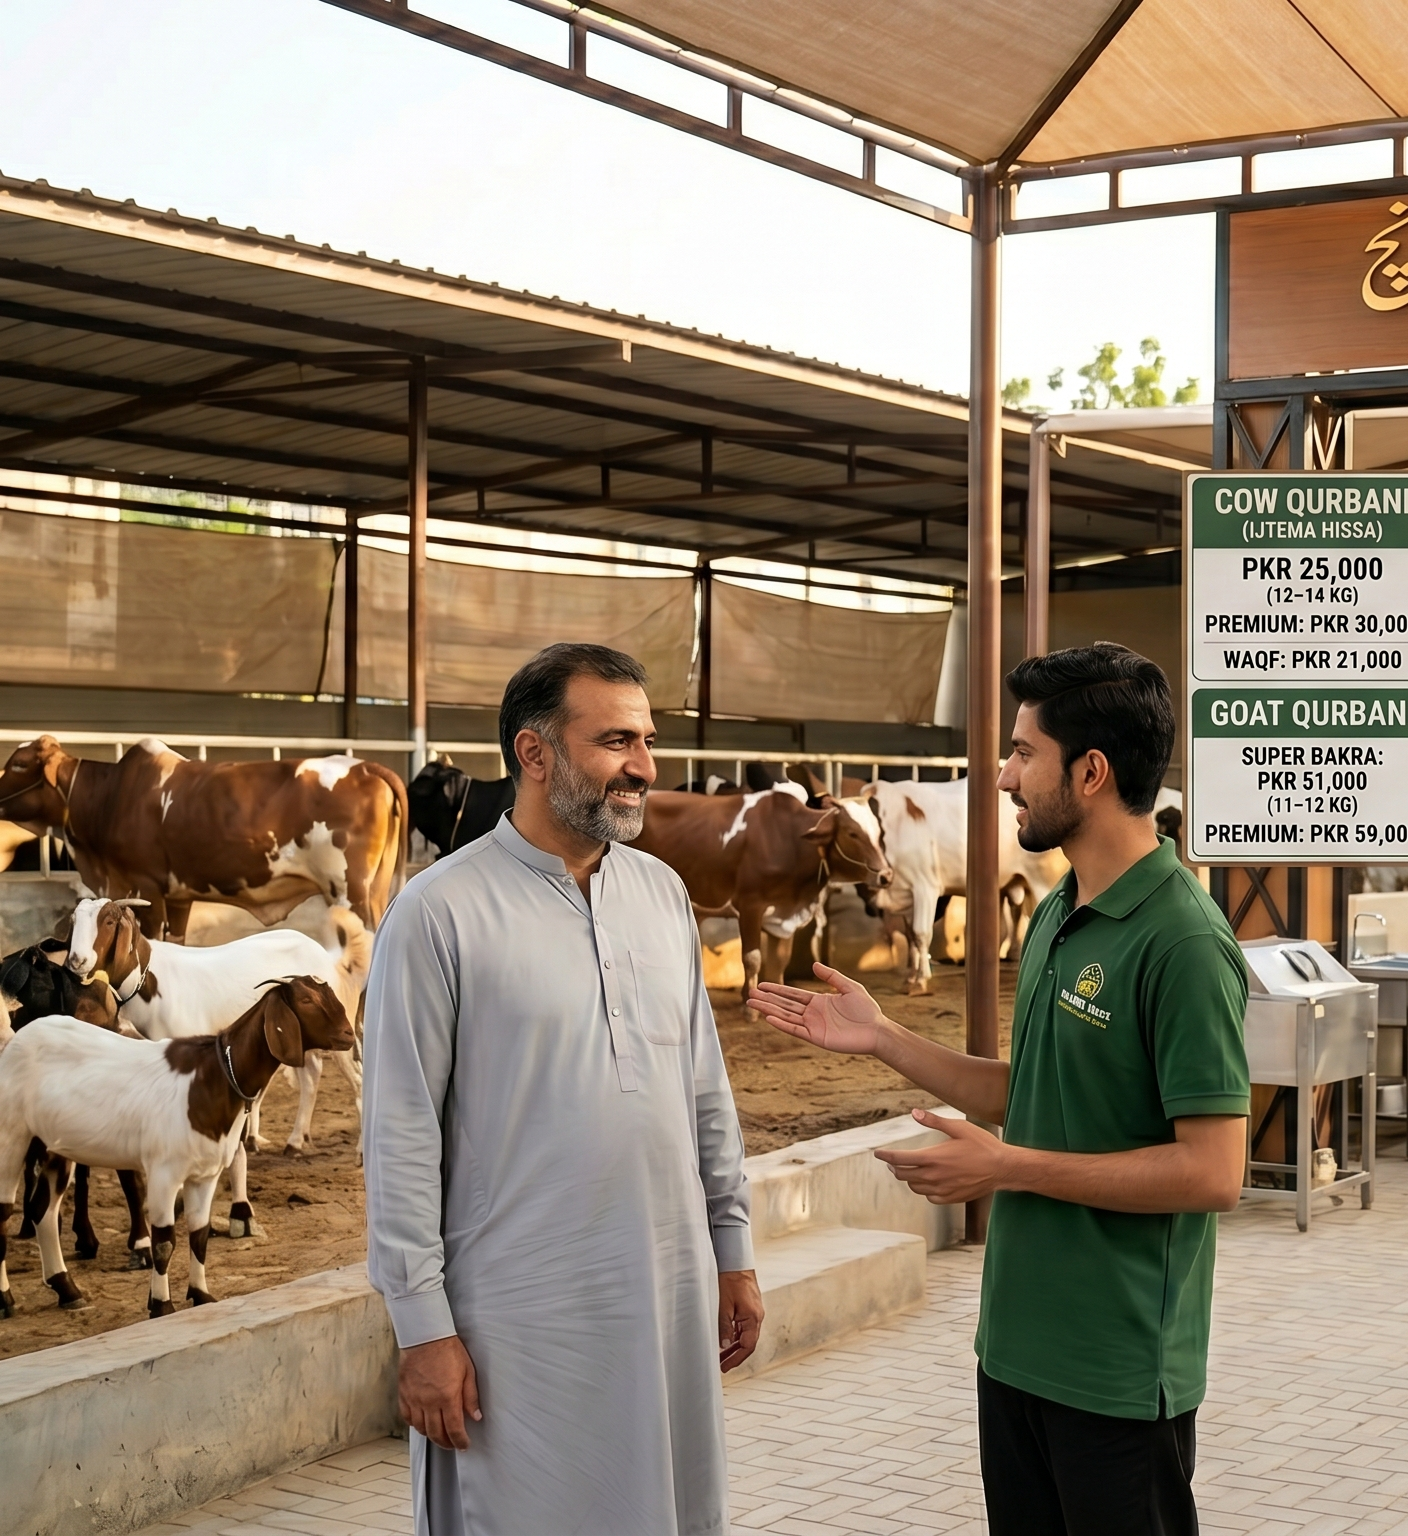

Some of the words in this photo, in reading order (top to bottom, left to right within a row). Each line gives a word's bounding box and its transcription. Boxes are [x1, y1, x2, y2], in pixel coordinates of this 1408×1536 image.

[1215, 488, 1278, 514] COW
[1242, 520, 1316, 542] (IJTEMA
[1322, 520, 1383, 542] HISSA)
[1242, 557, 1292, 580] PKR
[1300, 557, 1383, 585] 25,000
[1330, 586, 1359, 606] KG)
[1205, 615, 1304, 633] PREMIUM:
[1310, 615, 1349, 633] PKR
[1224, 651, 1286, 671] WAQF:
[1292, 651, 1331, 669] PKR
[1336, 651, 1402, 672] 21,000
[1210, 700, 1284, 726] GOAT
[1241, 746, 1305, 766] SUPER
[1311, 746, 1383, 766] BAKRA:
[1258, 771, 1297, 791] PKR
[1302, 771, 1368, 794] 51,000
[1329, 796, 1358, 817] KG)
[1205, 824, 1304, 843] PREMIUM:
[1310, 824, 1349, 843] PKR
